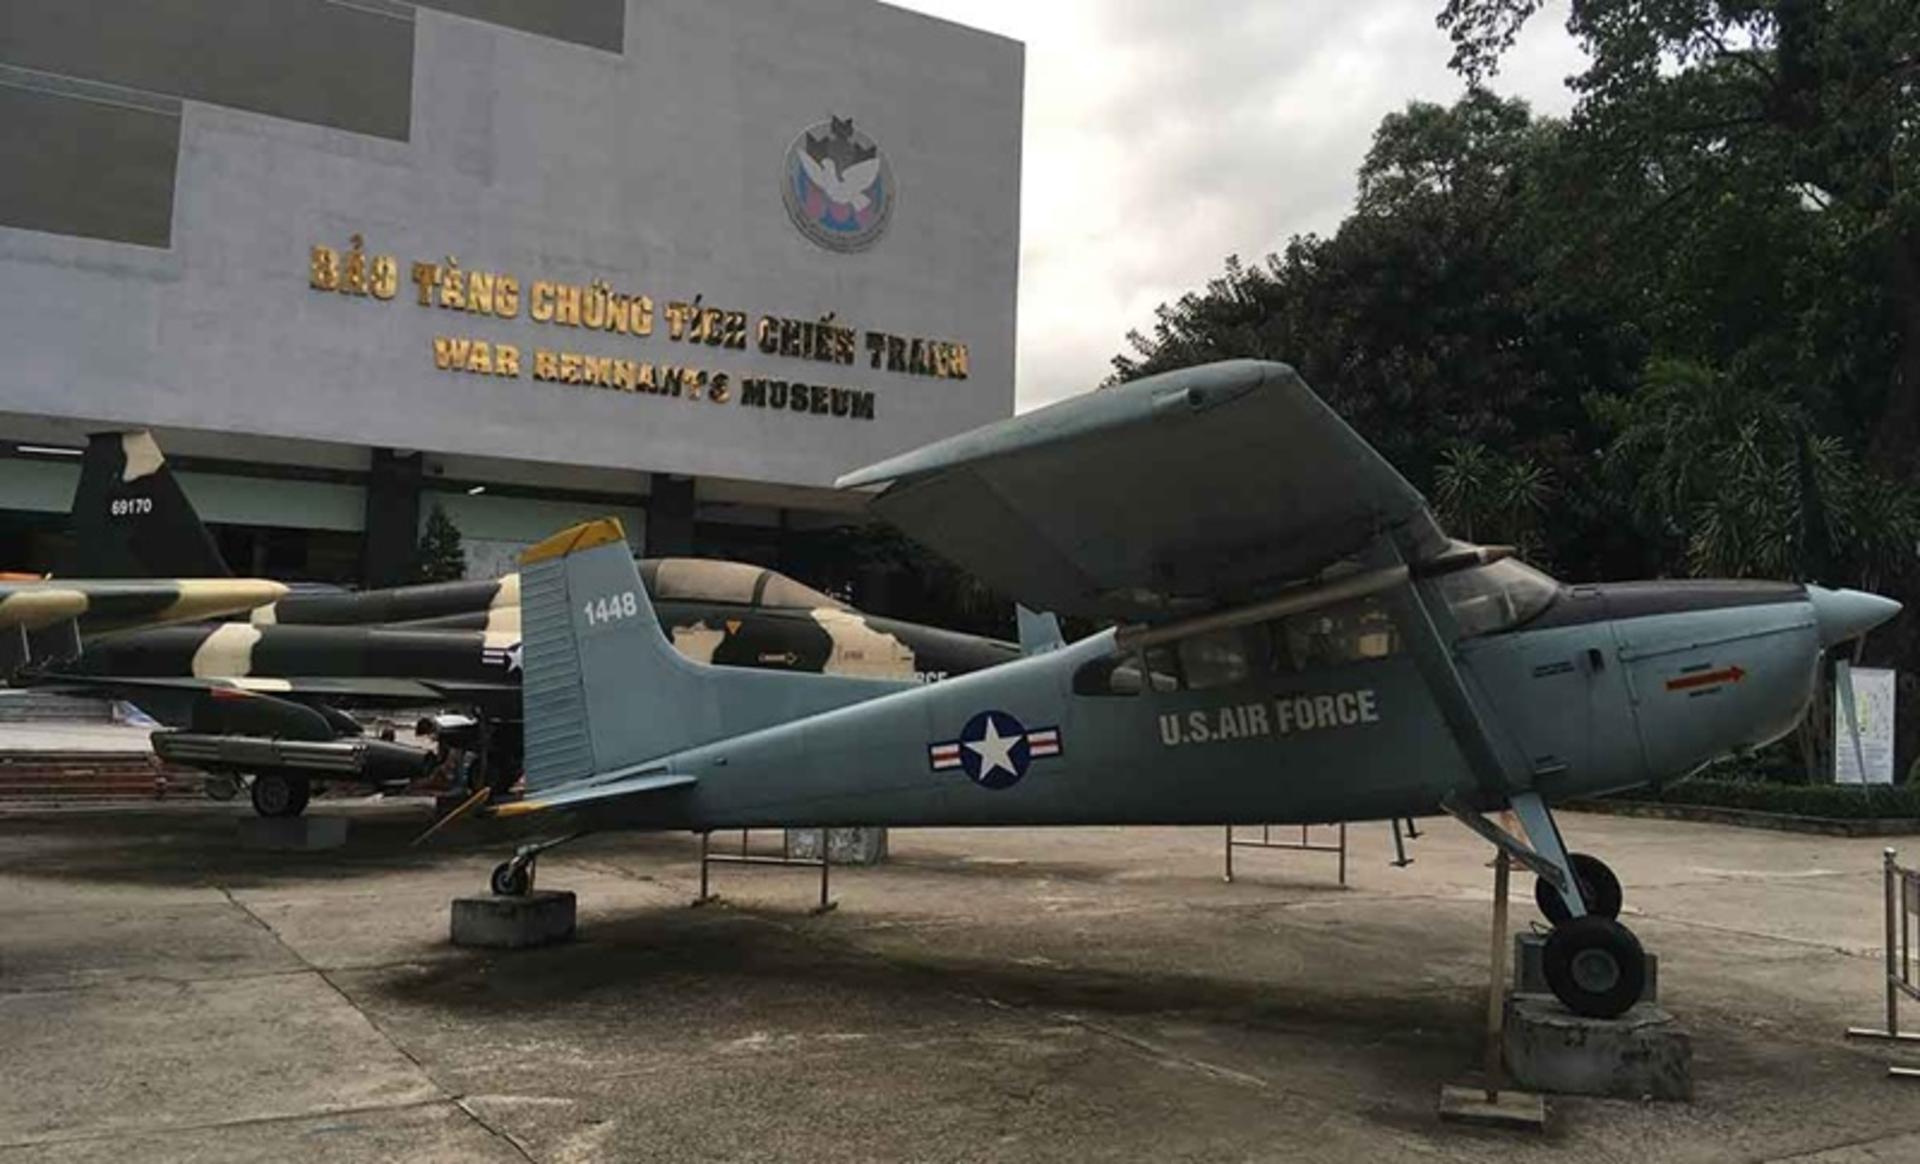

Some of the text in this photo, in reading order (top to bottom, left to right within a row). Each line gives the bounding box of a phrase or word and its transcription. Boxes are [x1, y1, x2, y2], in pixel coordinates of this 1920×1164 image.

[309, 233, 970, 381] BẢO TÀNG CHỨNG TÍCH CHIẾN TRANH
[433, 335, 876, 421] WAR REMNANTS MUSEUM
[111, 498, 153, 516] 69170
[584, 591, 637, 626] 1448
[1159, 690, 1379, 746] U.S.AIR FORCE
